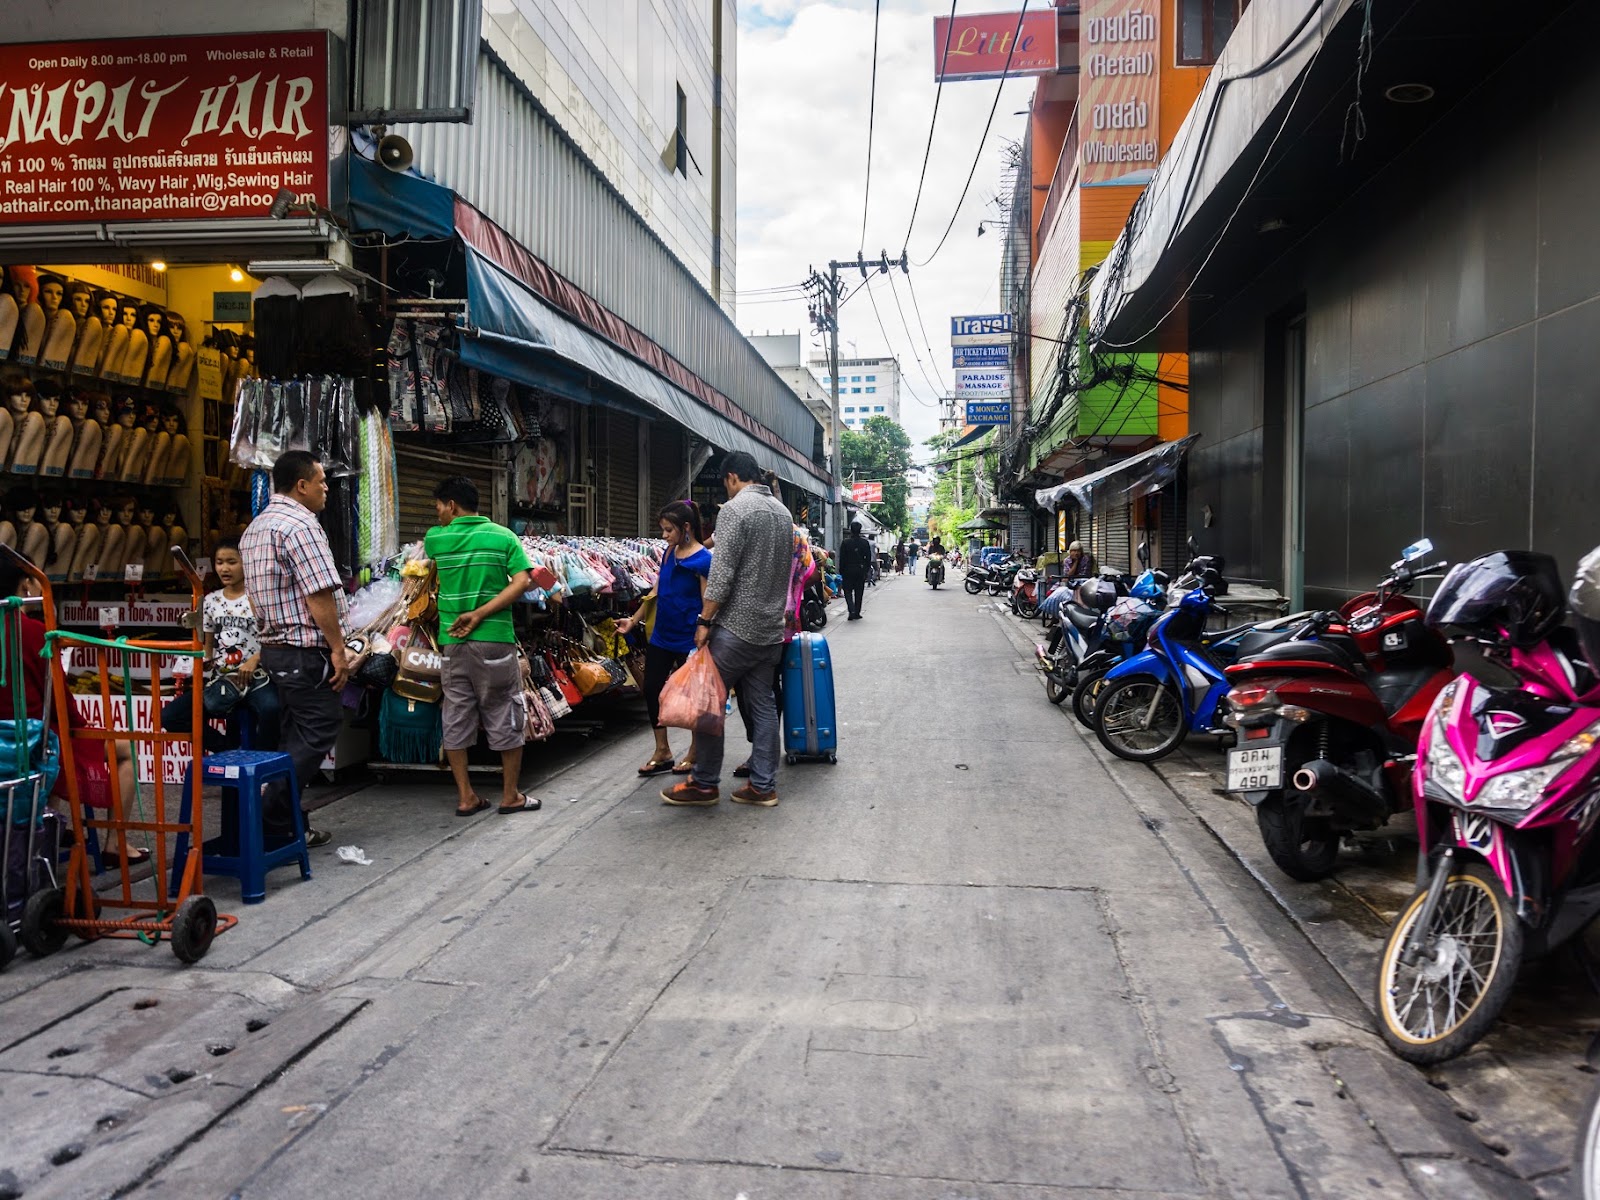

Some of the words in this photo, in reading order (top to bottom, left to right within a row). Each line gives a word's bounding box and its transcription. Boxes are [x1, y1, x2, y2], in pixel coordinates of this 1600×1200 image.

[1088, 8, 1154, 43] ขายปลีก
[947, 25, 1037, 56] Little
[28, 58, 58, 71] Open
[61, 56, 88, 69] Daily
[91, 55, 114, 66] 8.00
[116, 53, 167, 65] am-18.00
[169, 53, 188, 65] pm
[206, 48, 266, 61] Wholesale
[269, 48, 278, 58] &
[280, 46, 314, 58] Retail
[1088, 52, 1153, 79] (Retail)
[0, 76, 190, 153] NAPAT
[181, 71, 314, 147] HAIR
[1094, 95, 1147, 130] ขายส่ง
[18, 158, 45, 173] 100
[51, 157, 65, 171] %
[69, 153, 107, 171] วิกผม
[112, 149, 218, 174] อุปกรณ์เสริมสวย
[225, 145, 313, 166] รับเย็บเส้นผม
[1082, 138, 1157, 166] (Wholesale)
[5, 179, 35, 194] Real
[39, 179, 66, 193] Hair
[70, 178, 94, 192] 100
[99, 177, 115, 193] %,
[118, 176, 156, 193] Wavy
[160, 174, 189, 189] Hair
[283, 171, 313, 186] Hair
[954, 315, 1009, 334] Travel
[988, 346, 1009, 356] TRAVEL
[967, 414, 1009, 422] EXCHANGE
[128, 606, 154, 622] 100%
[1240, 775, 1268, 788] 490
